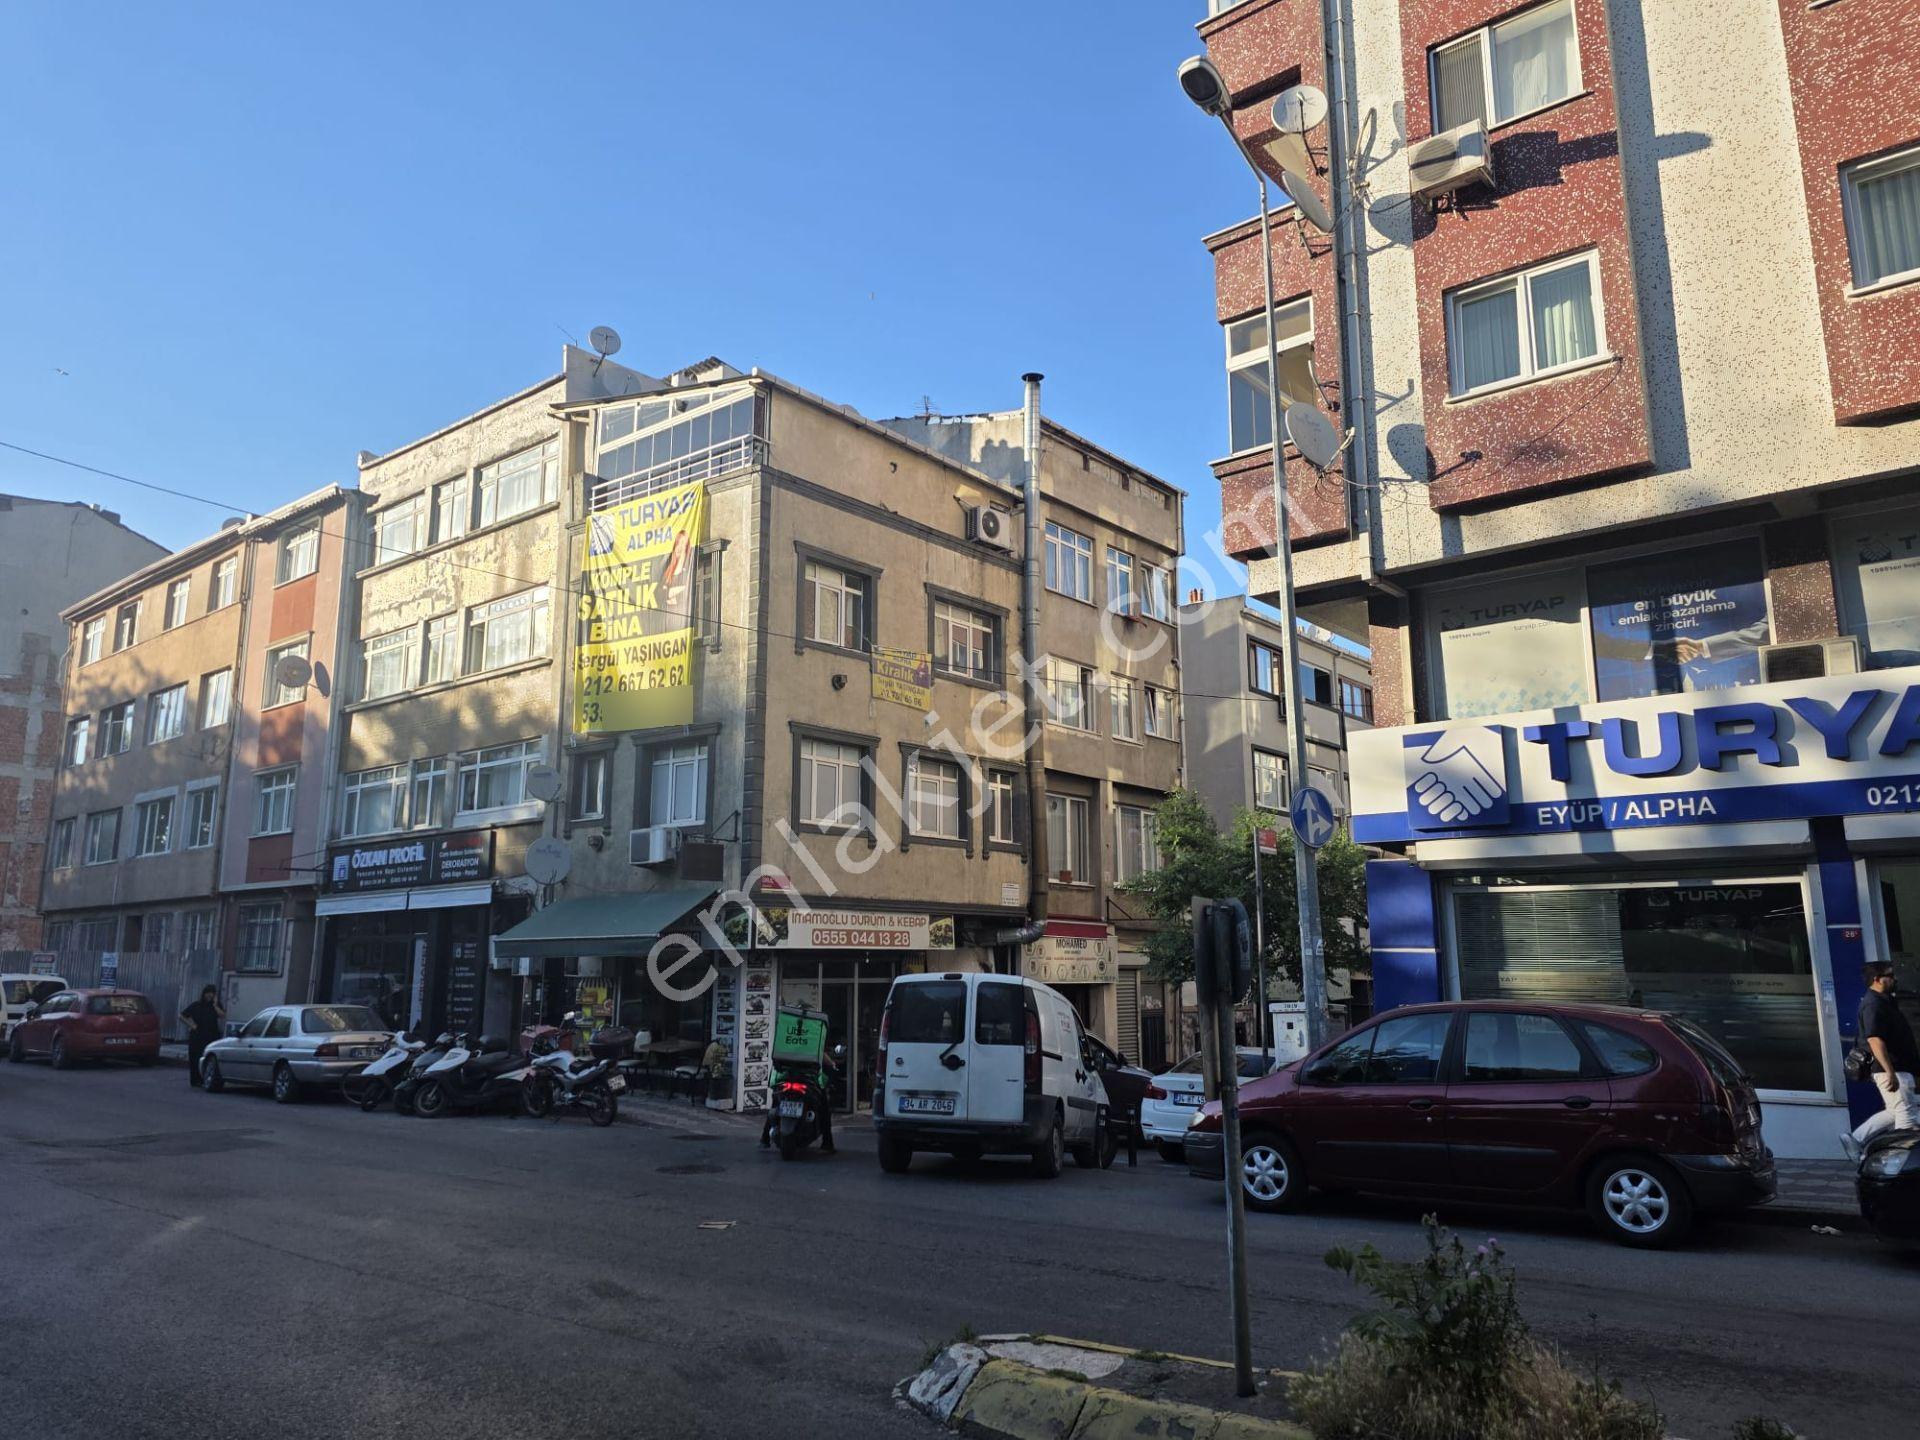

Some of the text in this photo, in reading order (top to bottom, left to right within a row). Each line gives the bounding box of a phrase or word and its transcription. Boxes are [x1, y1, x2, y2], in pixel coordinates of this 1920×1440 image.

[619, 491, 695, 529] TURYAP
[627, 525, 672, 551] ALPHA
[591, 562, 651, 592] KOMPLE
[578, 582, 658, 621] SATILIK
[1470, 596, 1566, 621] TURYAP
[1634, 588, 1717, 612] en büyük
[1618, 600, 1736, 626] emlak pazarlama
[1656, 617, 1699, 632] zinciri.
[624, 636, 688, 667] YAŞINGAN
[584, 664, 684, 696] 212 667 62 62
[1538, 799, 1603, 826] EYÜP
[1625, 796, 1717, 820] ALPHA
[352, 849, 387, 869] ÖZKAN
[389, 842, 426, 865] PROFİL
[1674, 889, 1762, 902] TURYAP
[888, 916, 895, 926] &
[897, 916, 926, 928] KEBAP
[813, 930, 909, 946] 0555 044 13 28
[1055, 938, 1087, 949] MOHAMED
[785, 1036, 808, 1045] Eats
[904, 1099, 914, 1108] 34
